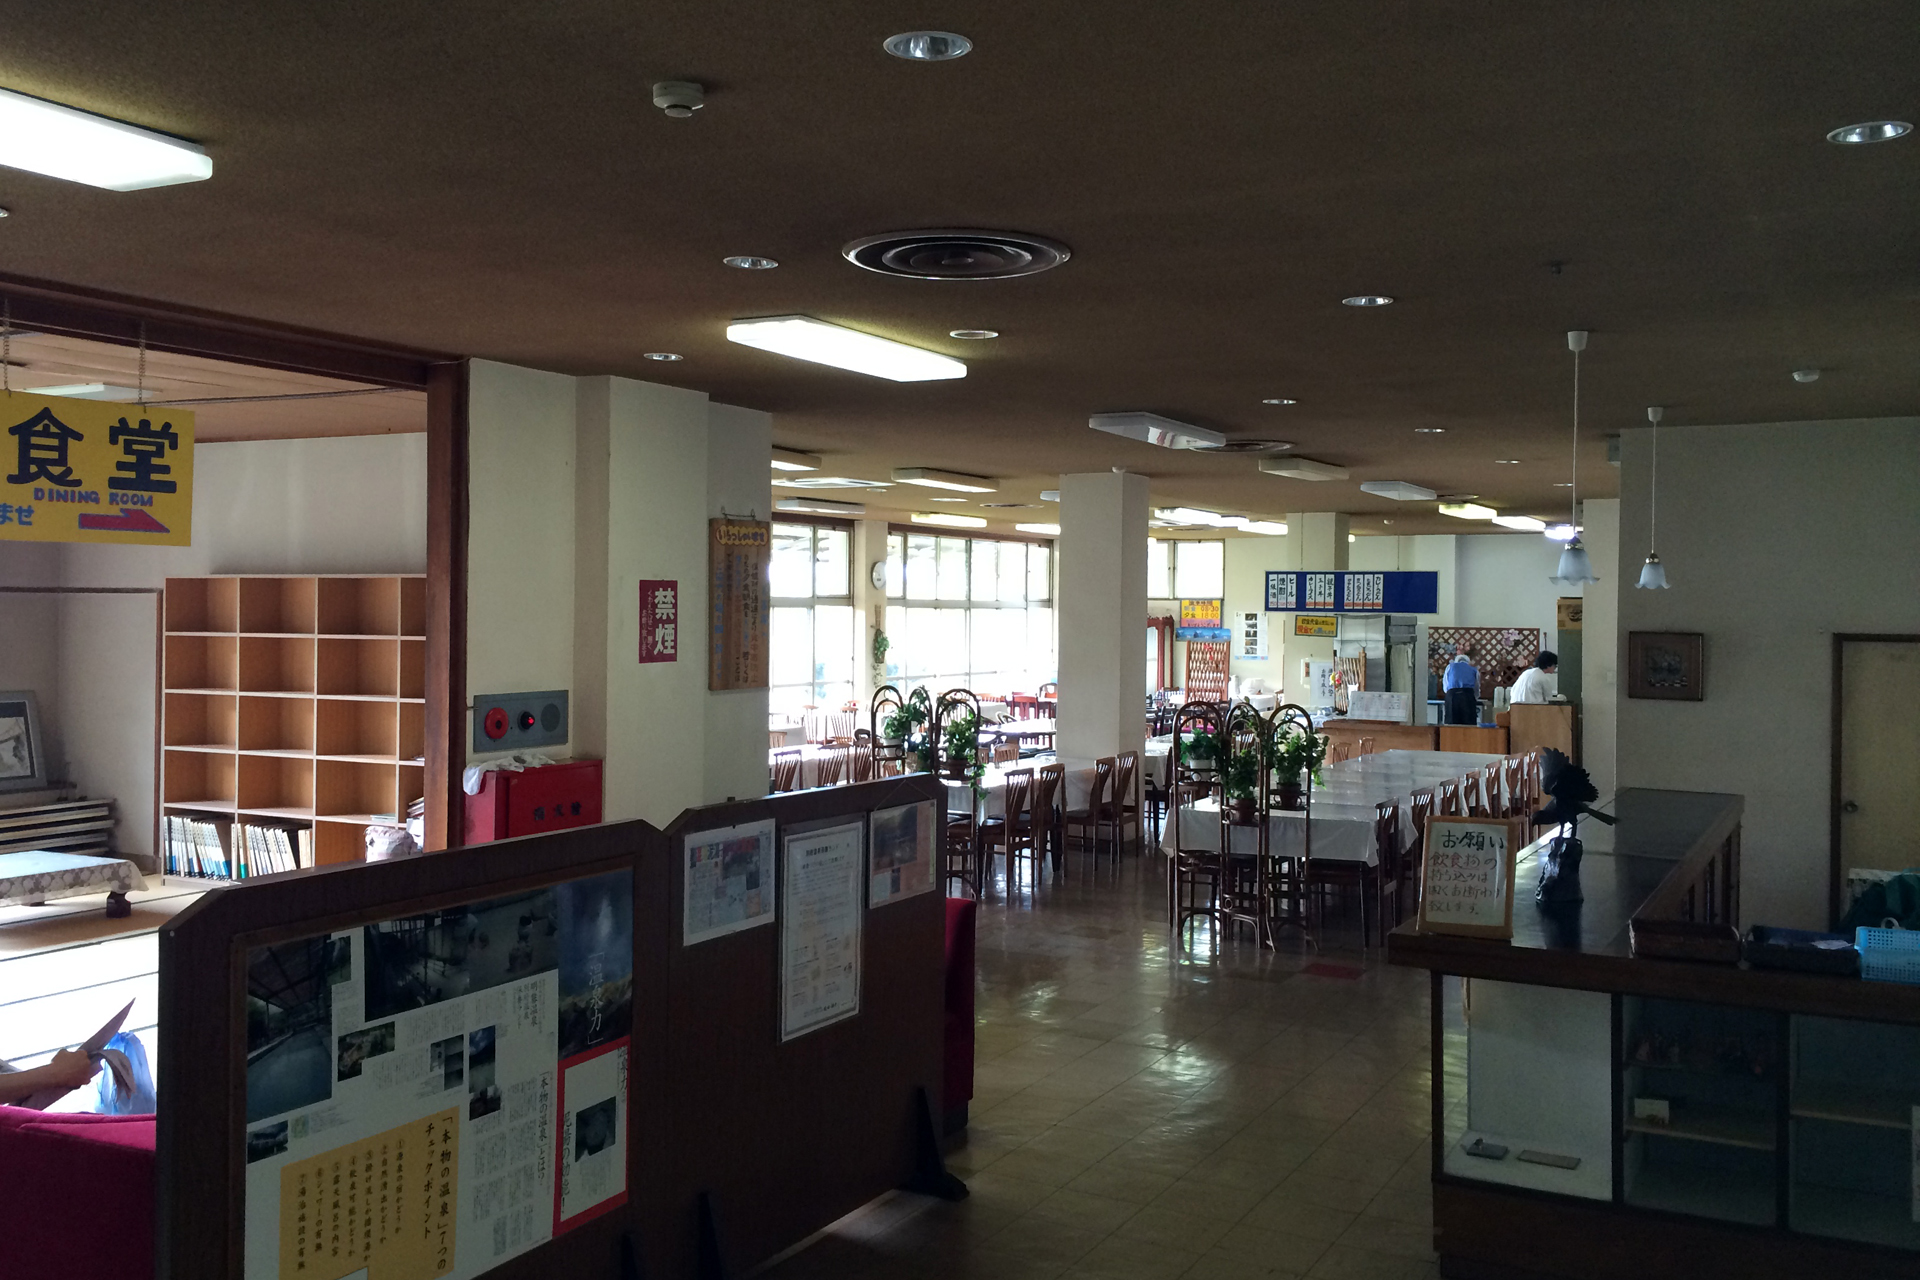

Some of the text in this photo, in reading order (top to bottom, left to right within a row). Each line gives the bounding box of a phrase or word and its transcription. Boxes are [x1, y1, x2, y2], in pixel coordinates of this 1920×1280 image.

[6, 407, 178, 493] 食堂
[34, 487, 153, 507] DINING ROOM
[653, 587, 676, 656] 禁煙
[1441, 830, 1505, 851] お願い
[1430, 852, 1498, 870] 飲食物の
[1428, 868, 1489, 884] 持ち込みは
[423, 1122, 436, 1240] チェックポイント
